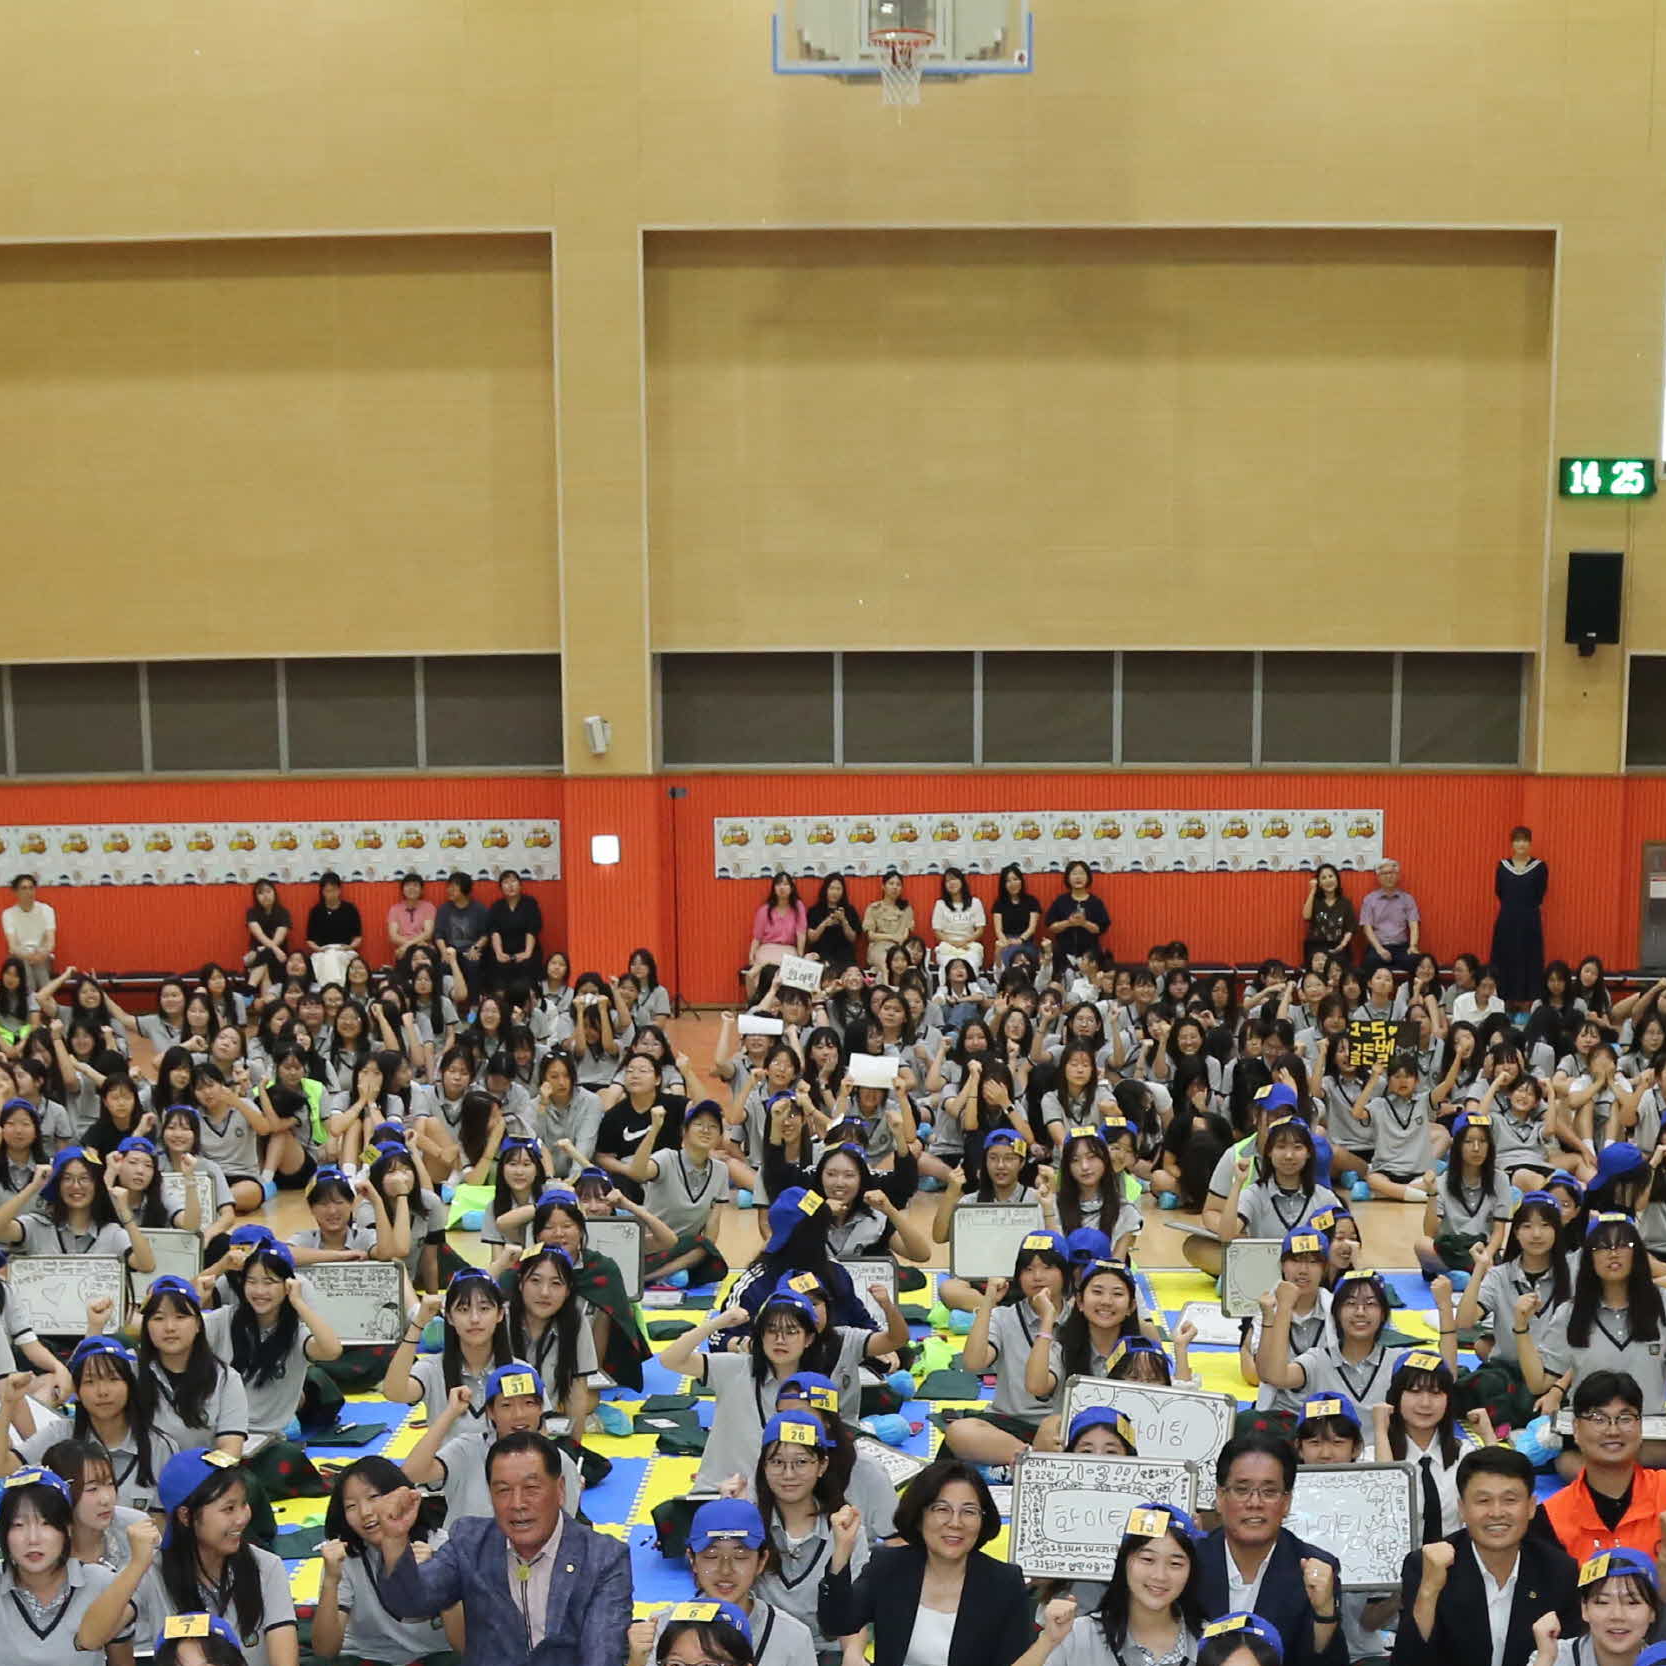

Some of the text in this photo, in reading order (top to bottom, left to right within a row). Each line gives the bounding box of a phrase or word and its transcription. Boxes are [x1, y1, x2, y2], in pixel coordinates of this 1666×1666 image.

[1569, 460, 1645, 494] 14 25
[511, 1382, 525, 1394] 37
[791, 1430, 805, 1441] 26
[183, 1623, 191, 1635] 7
